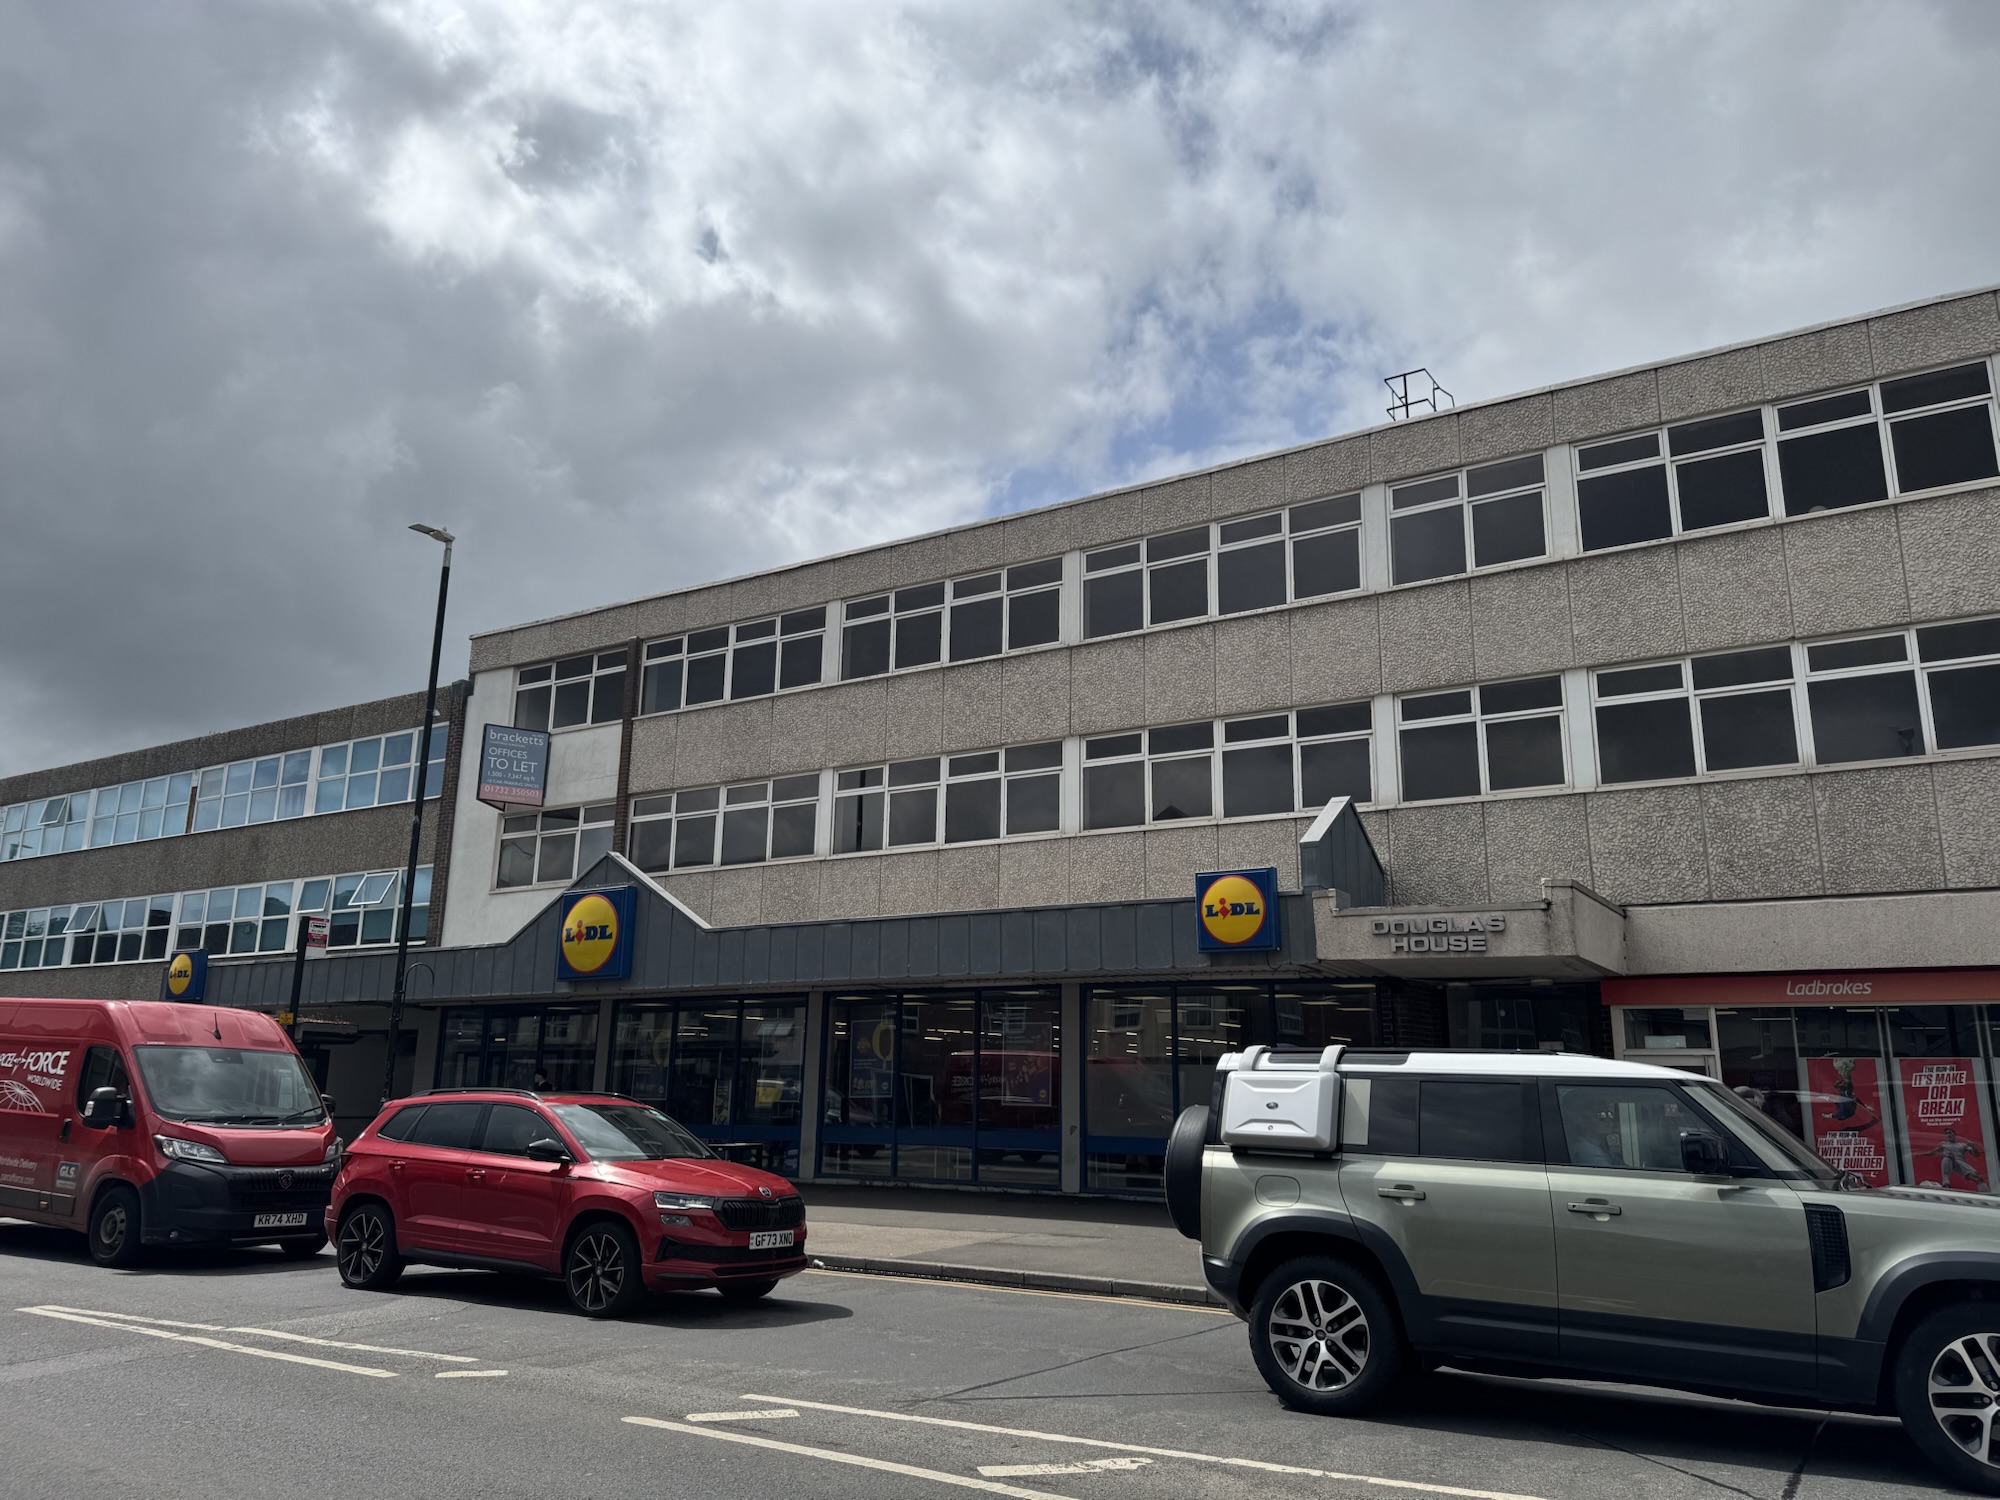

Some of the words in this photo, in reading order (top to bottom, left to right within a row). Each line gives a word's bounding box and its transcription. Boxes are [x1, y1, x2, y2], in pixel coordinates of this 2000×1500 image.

[490, 729, 544, 746] bracketts
[488, 747, 528, 759] OFFICES
[488, 757, 508, 770] TO
[512, 760, 538, 773] LET
[484, 784, 508, 794] 01732
[511, 788, 539, 798] 350503
[1205, 898, 1260, 920] LIDL
[1372, 914, 1506, 934] DOUGLAS
[564, 920, 612, 945] LIDL
[1391, 935, 1487, 952] HOUSE
[1786, 980, 1872, 996] Ladbrokes
[23, 1051, 71, 1075] FORCE
[27, 1074, 63, 1091] WORLDWIDE
[1914, 1074, 1933, 1086] IT'S
[1934, 1072, 1964, 1084] MAKE
[1930, 1086, 1948, 1099] OR
[1921, 1100, 1963, 1115] BREAK
[1821, 1147, 1842, 1156] WITH
[1845, 1147, 1850, 1156] A
[1853, 1146, 1873, 1156] FREE
[1844, 1158, 1882, 1169] BUILDER
[258, 1214, 282, 1225] KR74
[285, 1214, 304, 1224] XHD
[756, 1234, 777, 1246] GF73
